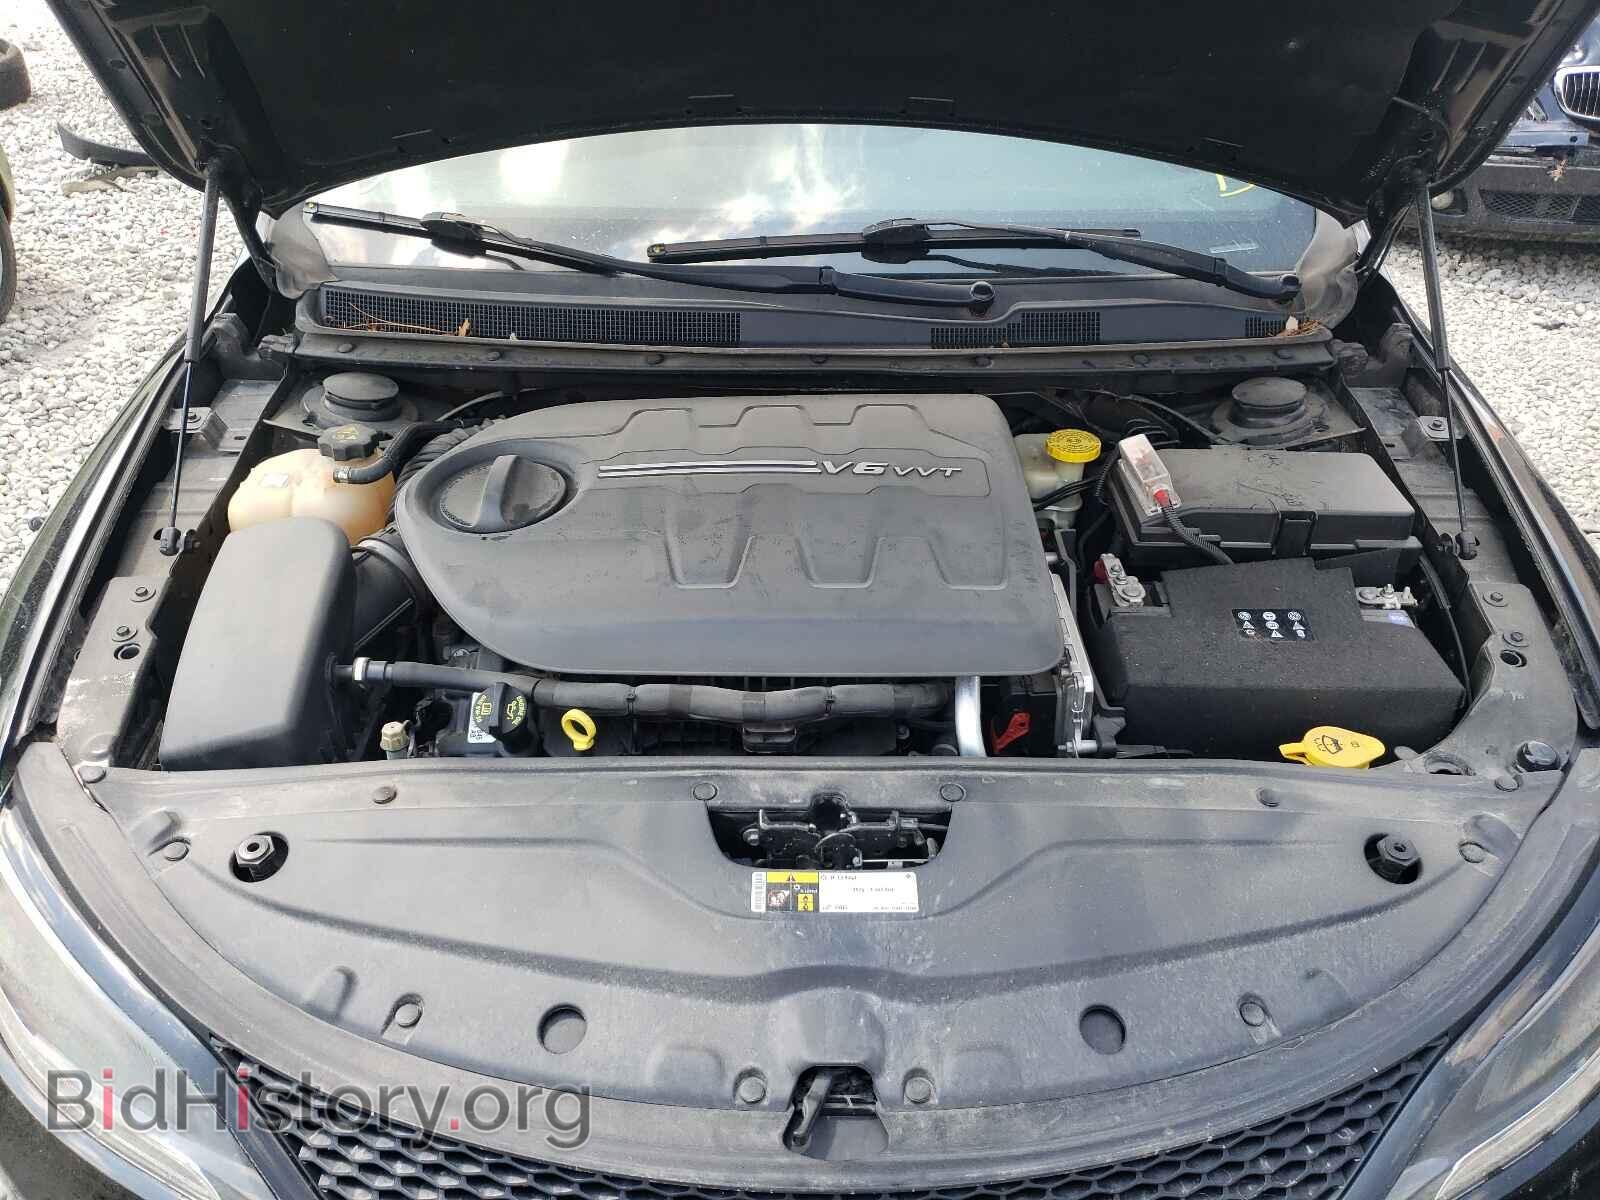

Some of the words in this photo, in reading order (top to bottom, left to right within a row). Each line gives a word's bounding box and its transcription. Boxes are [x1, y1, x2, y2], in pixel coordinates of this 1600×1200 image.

[822, 460, 889, 475] V6
[893, 465, 962, 478] VVT
[516, 695, 526, 716] ENGINE
[511, 716, 522, 727] OIL
